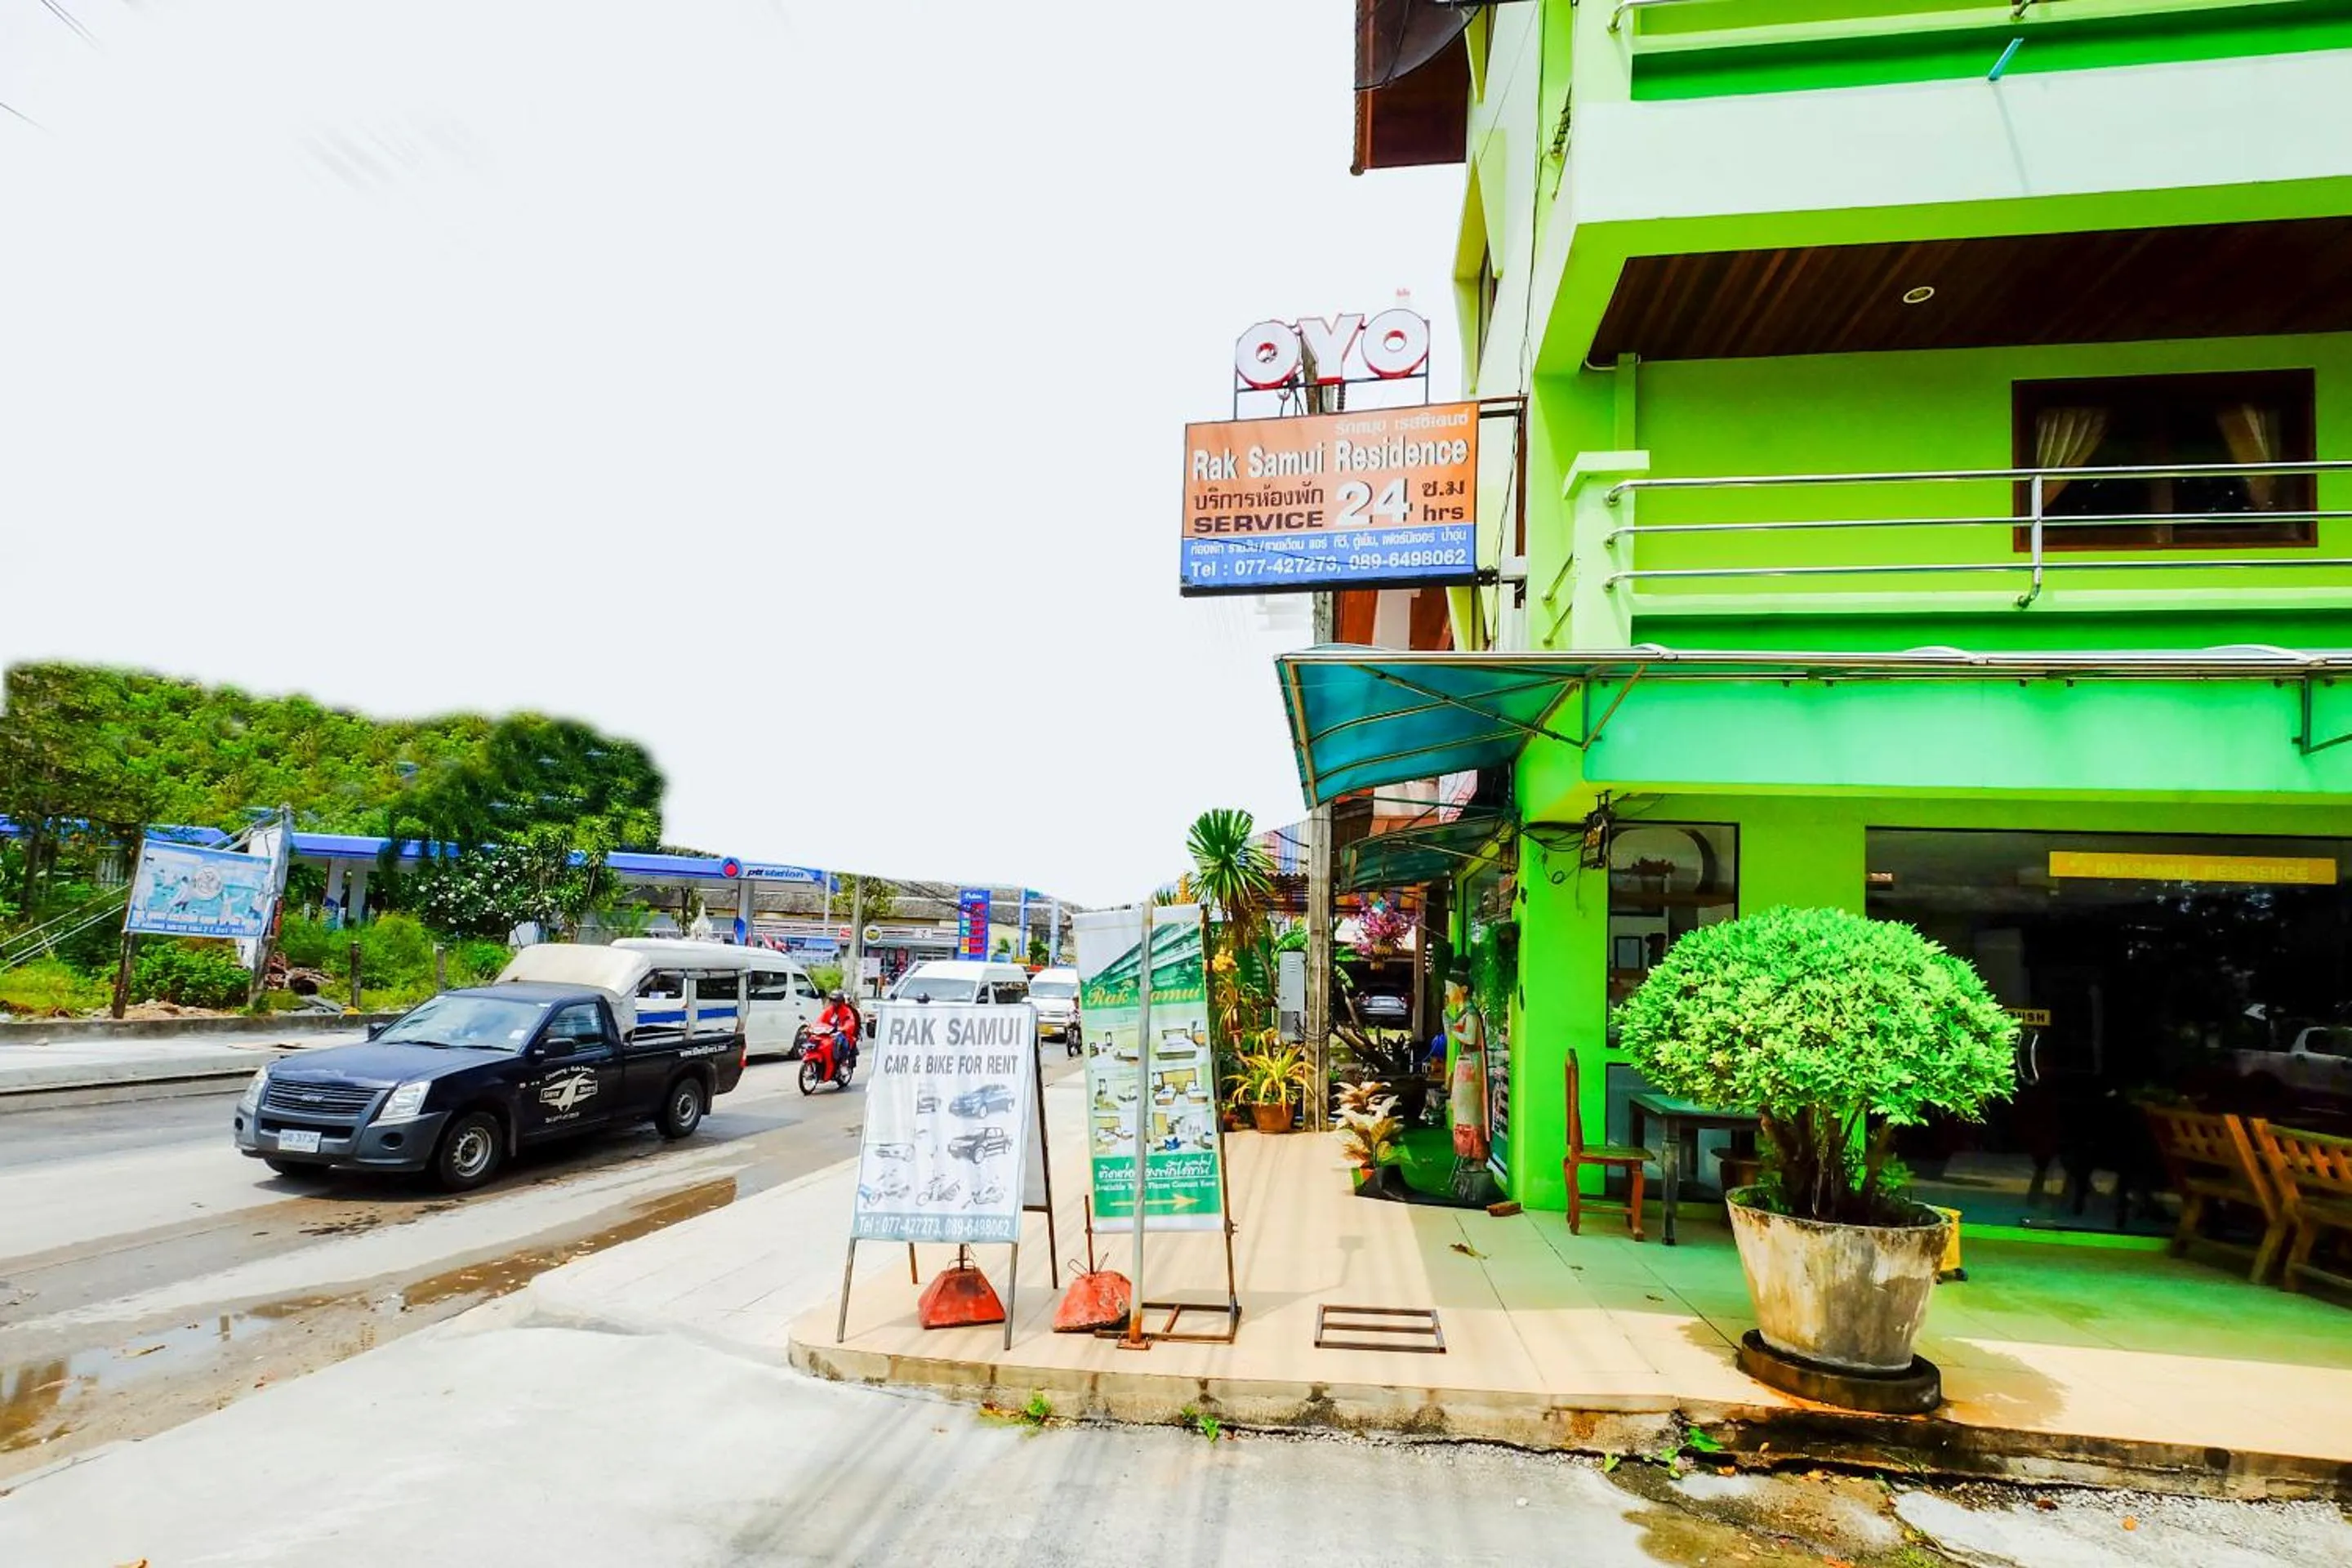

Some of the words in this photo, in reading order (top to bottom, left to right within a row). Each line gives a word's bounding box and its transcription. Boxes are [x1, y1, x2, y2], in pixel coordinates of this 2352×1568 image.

[1236, 309, 1429, 389] OYO
[1192, 447, 1239, 480] Rak
[1248, 442, 1325, 478] Samui
[1335, 434, 1468, 473] Residence
[1193, 481, 1325, 510] บริการห้องพัก
[1335, 477, 1414, 527] 24
[1193, 510, 1324, 533] SERVICE
[1423, 503, 1464, 523] hrs
[1191, 560, 1216, 577] Tel
[1234, 555, 1342, 576] 077-427273,
[1349, 548, 1467, 570] 089-6498062
[2204, 864, 2310, 880] RESIDENCE
[1136, 982, 1200, 1004] amui
[888, 1017, 937, 1047] RAK
[946, 1017, 1023, 1047] SAMUI
[884, 1054, 908, 1074] CAR
[913, 1056, 922, 1074] &
[924, 1054, 953, 1074] BIKE
[958, 1054, 982, 1074] FOR
[987, 1054, 1019, 1074] RENT
[858, 1216, 874, 1232] Tel
